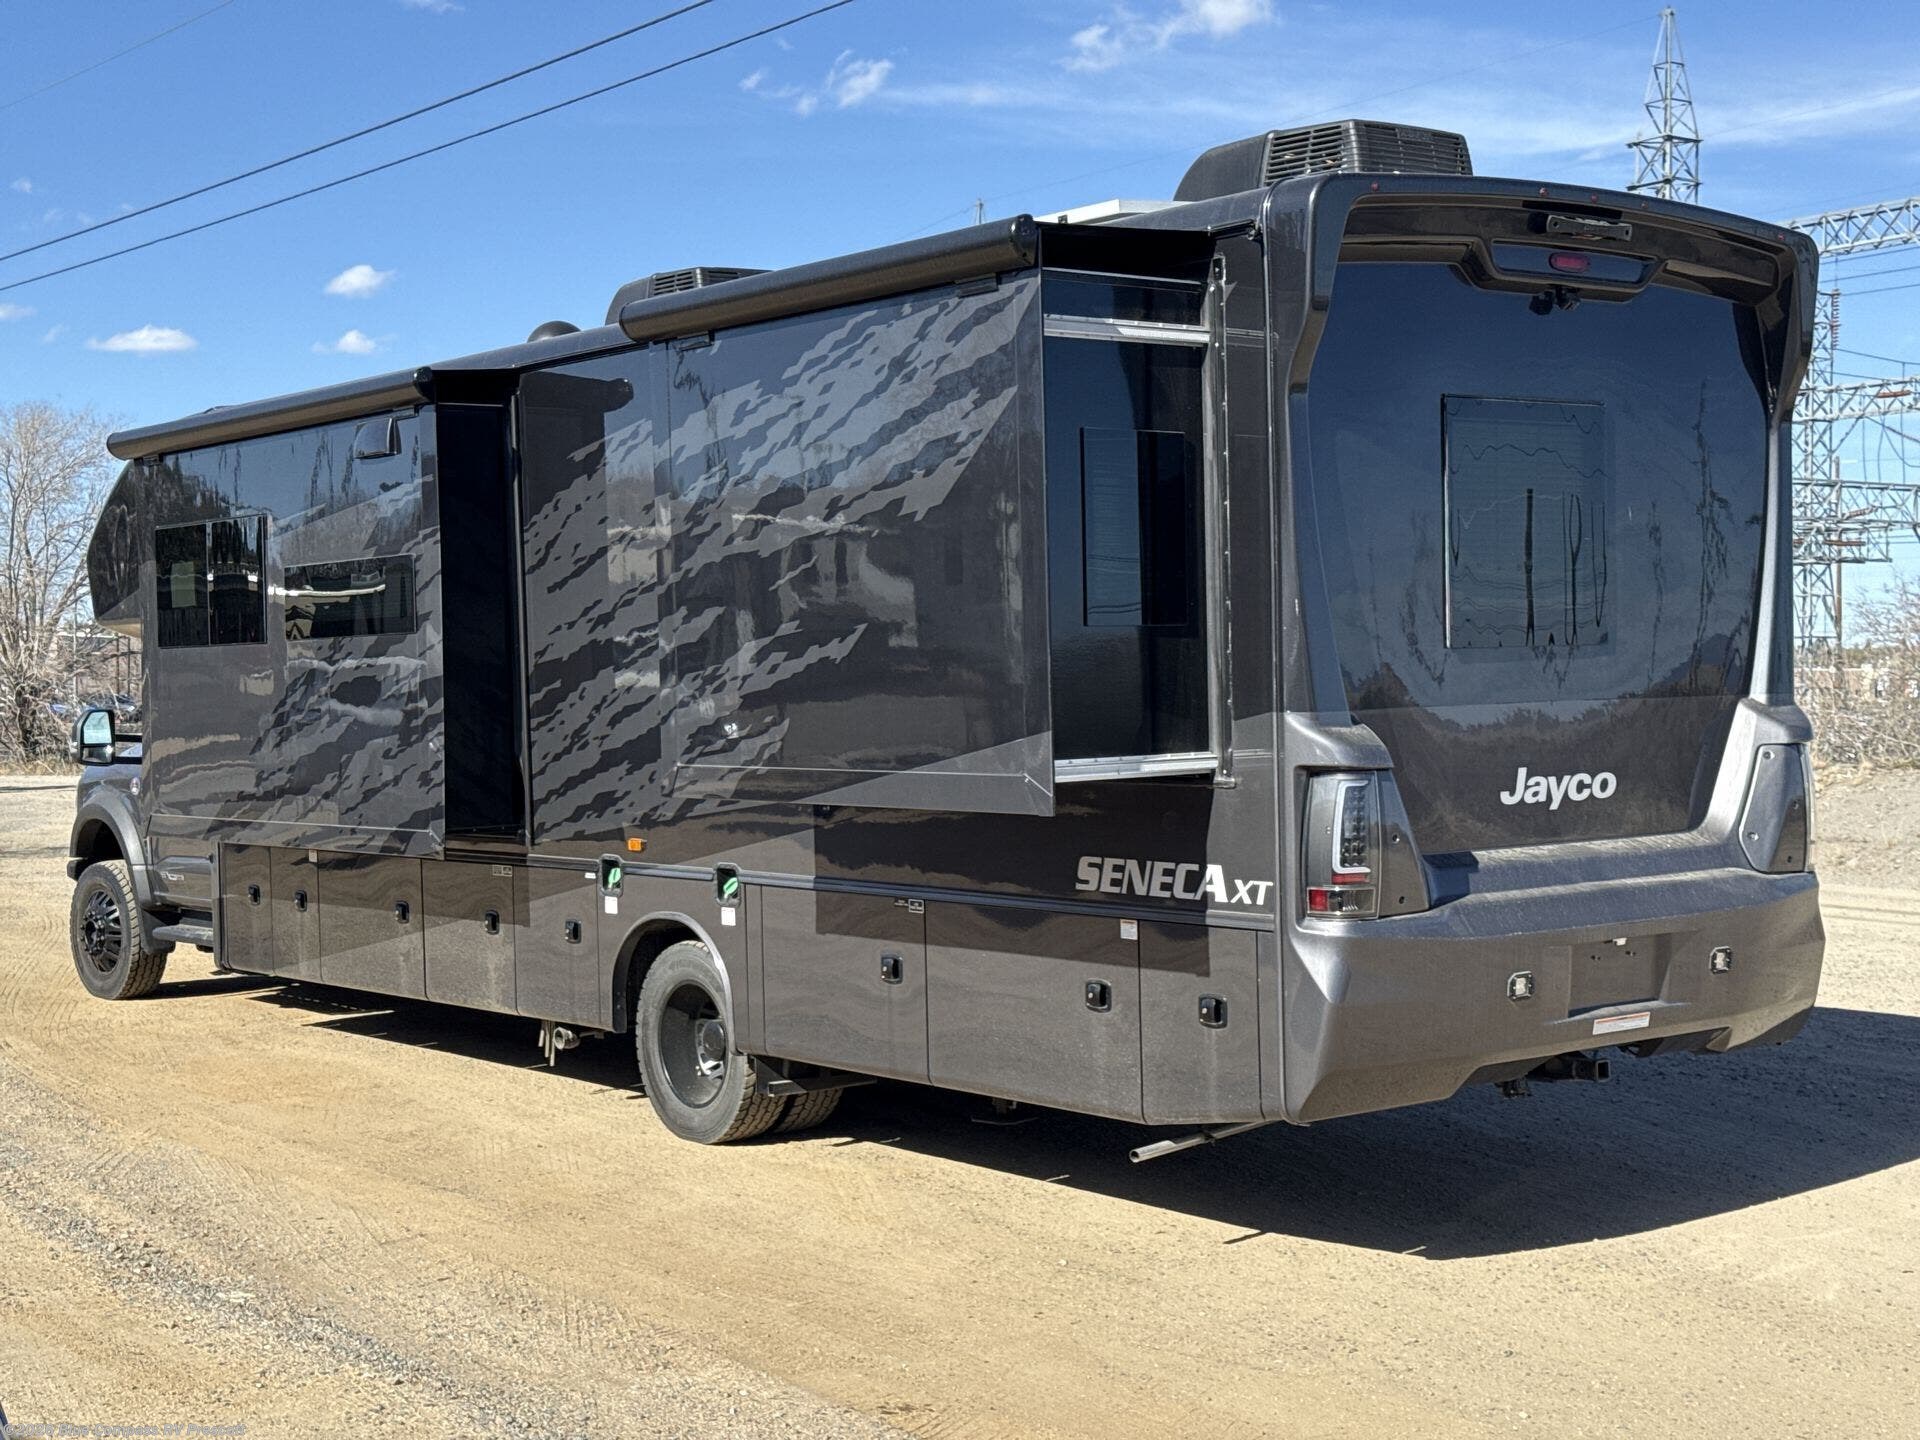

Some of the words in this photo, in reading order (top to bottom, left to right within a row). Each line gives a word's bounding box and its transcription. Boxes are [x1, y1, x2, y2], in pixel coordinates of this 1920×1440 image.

[1500, 767, 1617, 811] Jayco
[1075, 855, 1229, 903] SENECA
[1230, 879, 1274, 906] XT
